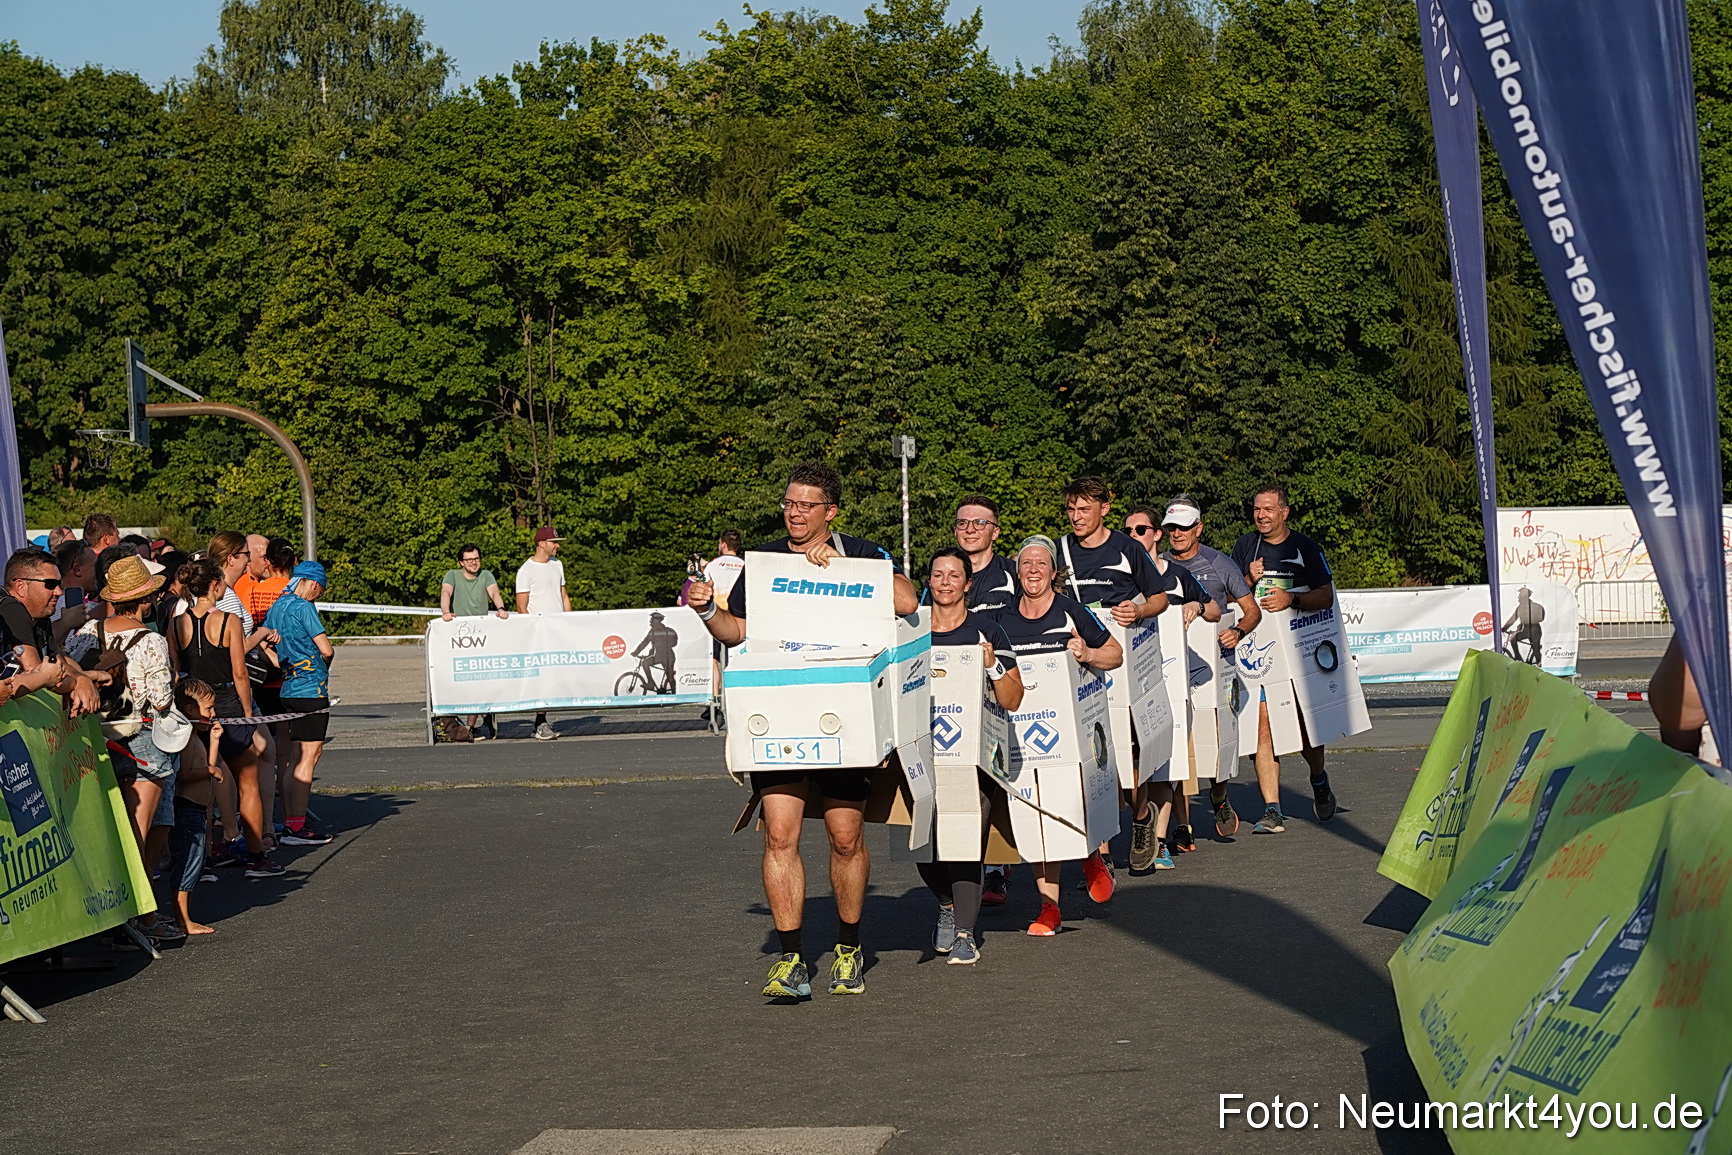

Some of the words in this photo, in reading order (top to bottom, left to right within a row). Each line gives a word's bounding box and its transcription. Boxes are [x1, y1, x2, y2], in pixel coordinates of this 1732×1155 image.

[772, 577, 875, 599] Schmidt
[1290, 608, 1333, 631] Schmidt
[1341, 613, 1364, 625] OW
[451, 635, 487, 649] NOW
[1348, 634, 1381, 646] BIKES
[1384, 633, 1394, 643] &
[1396, 627, 1475, 643] FAHRRÄDER
[455, 657, 508, 671] E-BIKES
[510, 656, 521, 668] &
[524, 651, 605, 667] FAHRRÄDER
[500, 669, 538, 679] BIKE-STORE
[931, 703, 963, 714] sratio
[12, 873, 58, 916] neumarkt
